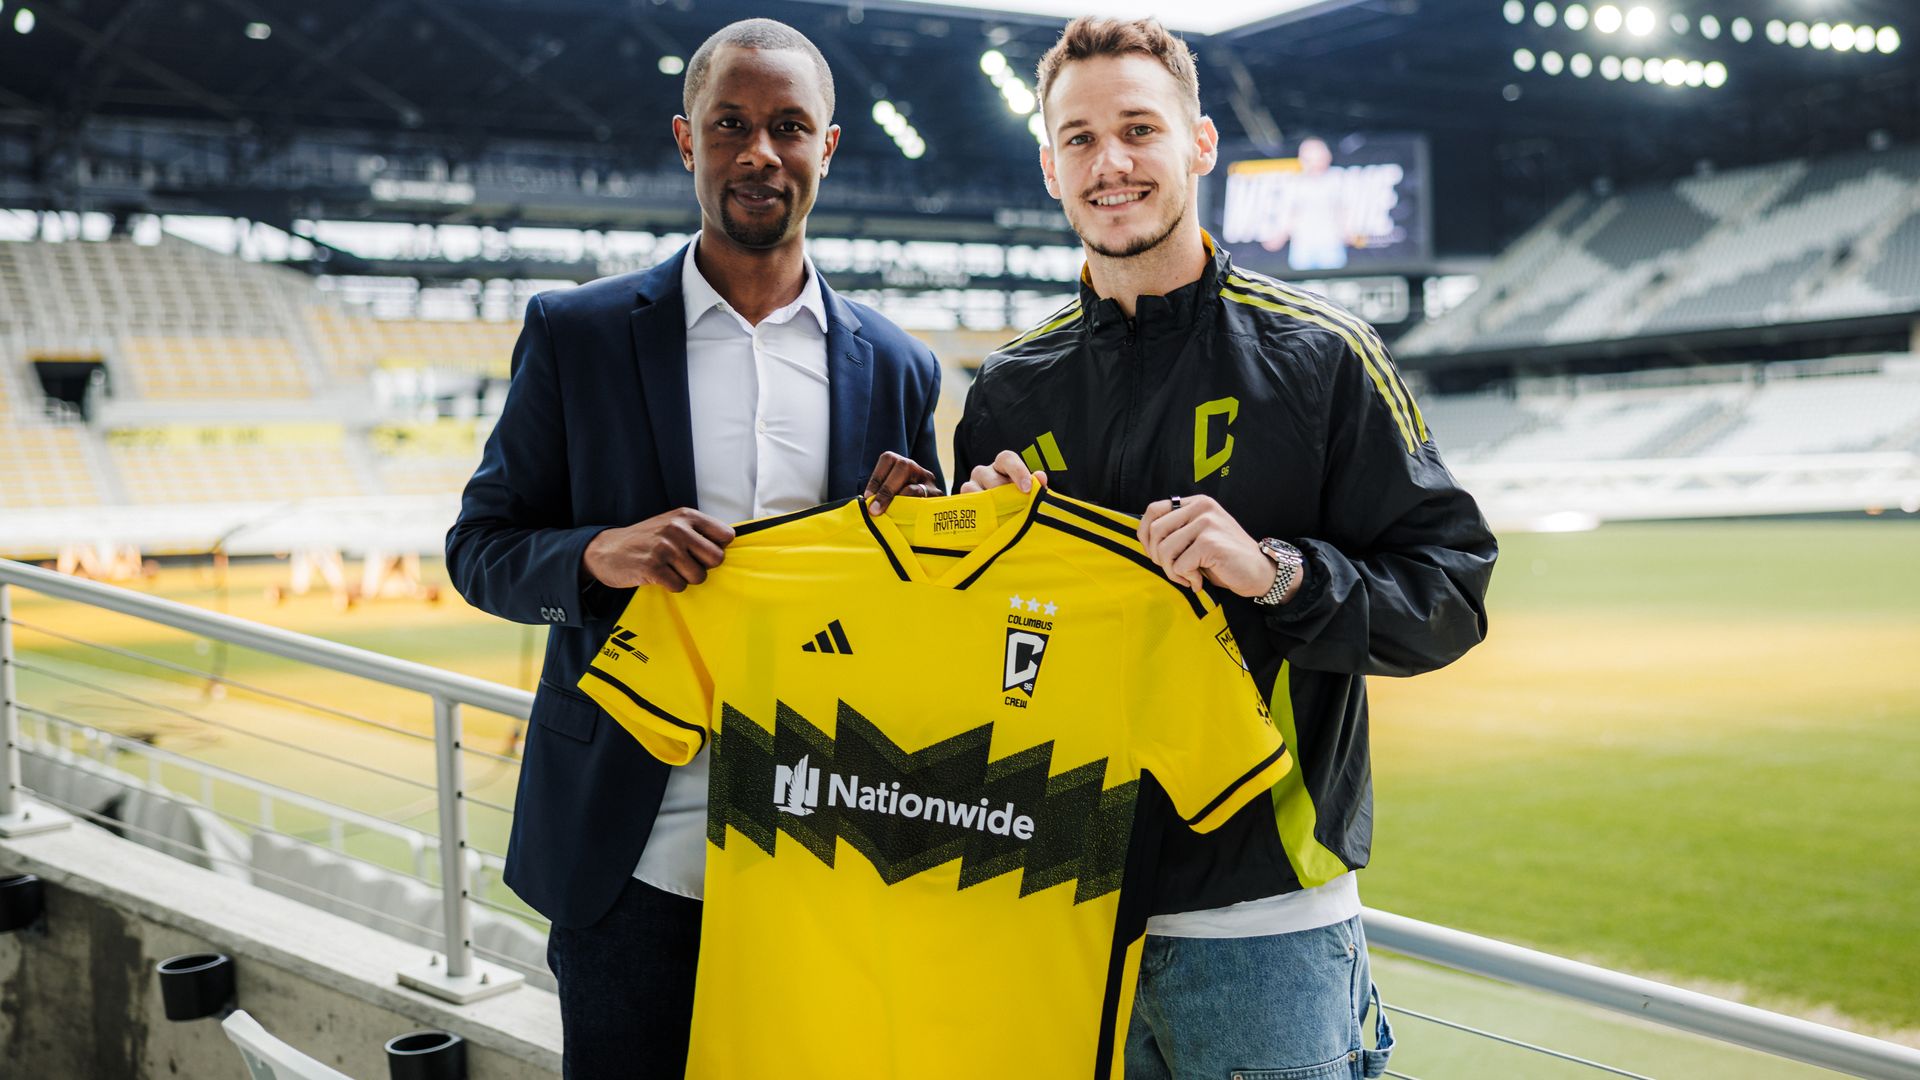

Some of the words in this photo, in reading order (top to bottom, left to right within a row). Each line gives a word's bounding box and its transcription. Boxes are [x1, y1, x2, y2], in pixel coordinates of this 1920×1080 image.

[1194, 396, 1239, 483] C
[933, 510, 958, 522] TODOS
[960, 509, 976, 519] SON
[933, 518, 976, 532] INVITADOS
[1007, 614, 1053, 631] COLUMBUS
[1220, 631, 1235, 646] ML
[601, 646, 620, 661] ain
[1005, 631, 1045, 688] C
[1023, 682, 1033, 691] 96
[1004, 696, 1028, 709] CREW
[828, 773, 1035, 840] Nationwide
